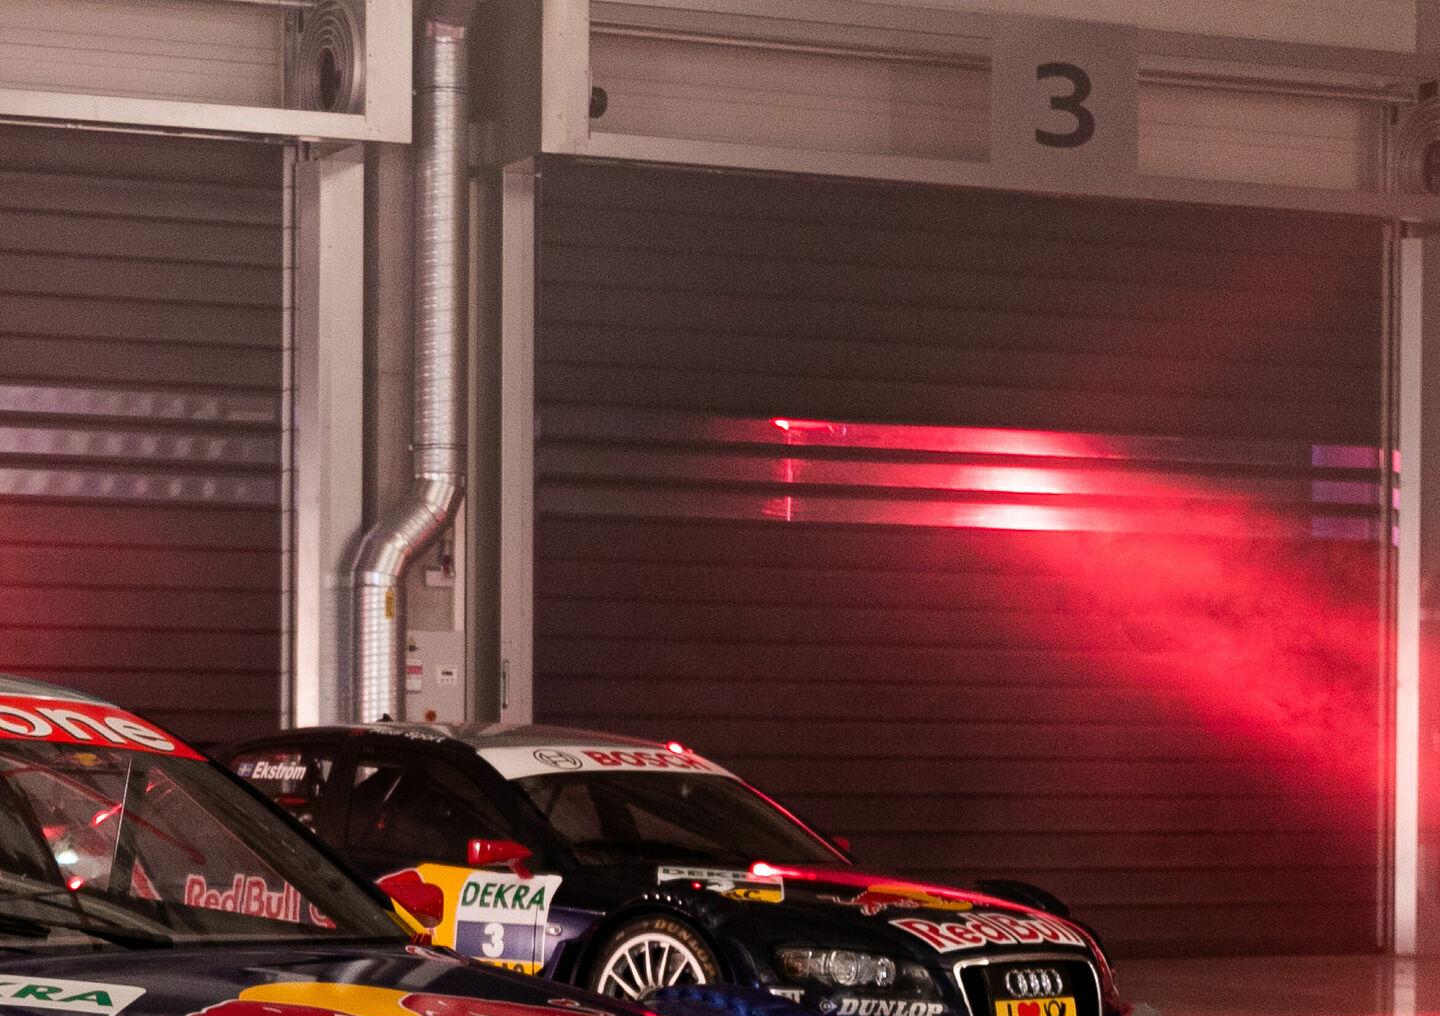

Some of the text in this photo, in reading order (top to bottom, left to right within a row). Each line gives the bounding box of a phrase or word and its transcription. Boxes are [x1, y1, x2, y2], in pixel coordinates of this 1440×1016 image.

[1035, 61, 1095, 149] 3
[251, 761, 307, 781] Ekström
[461, 881, 546, 911] DEKRA
[481, 922, 505, 958] 3
